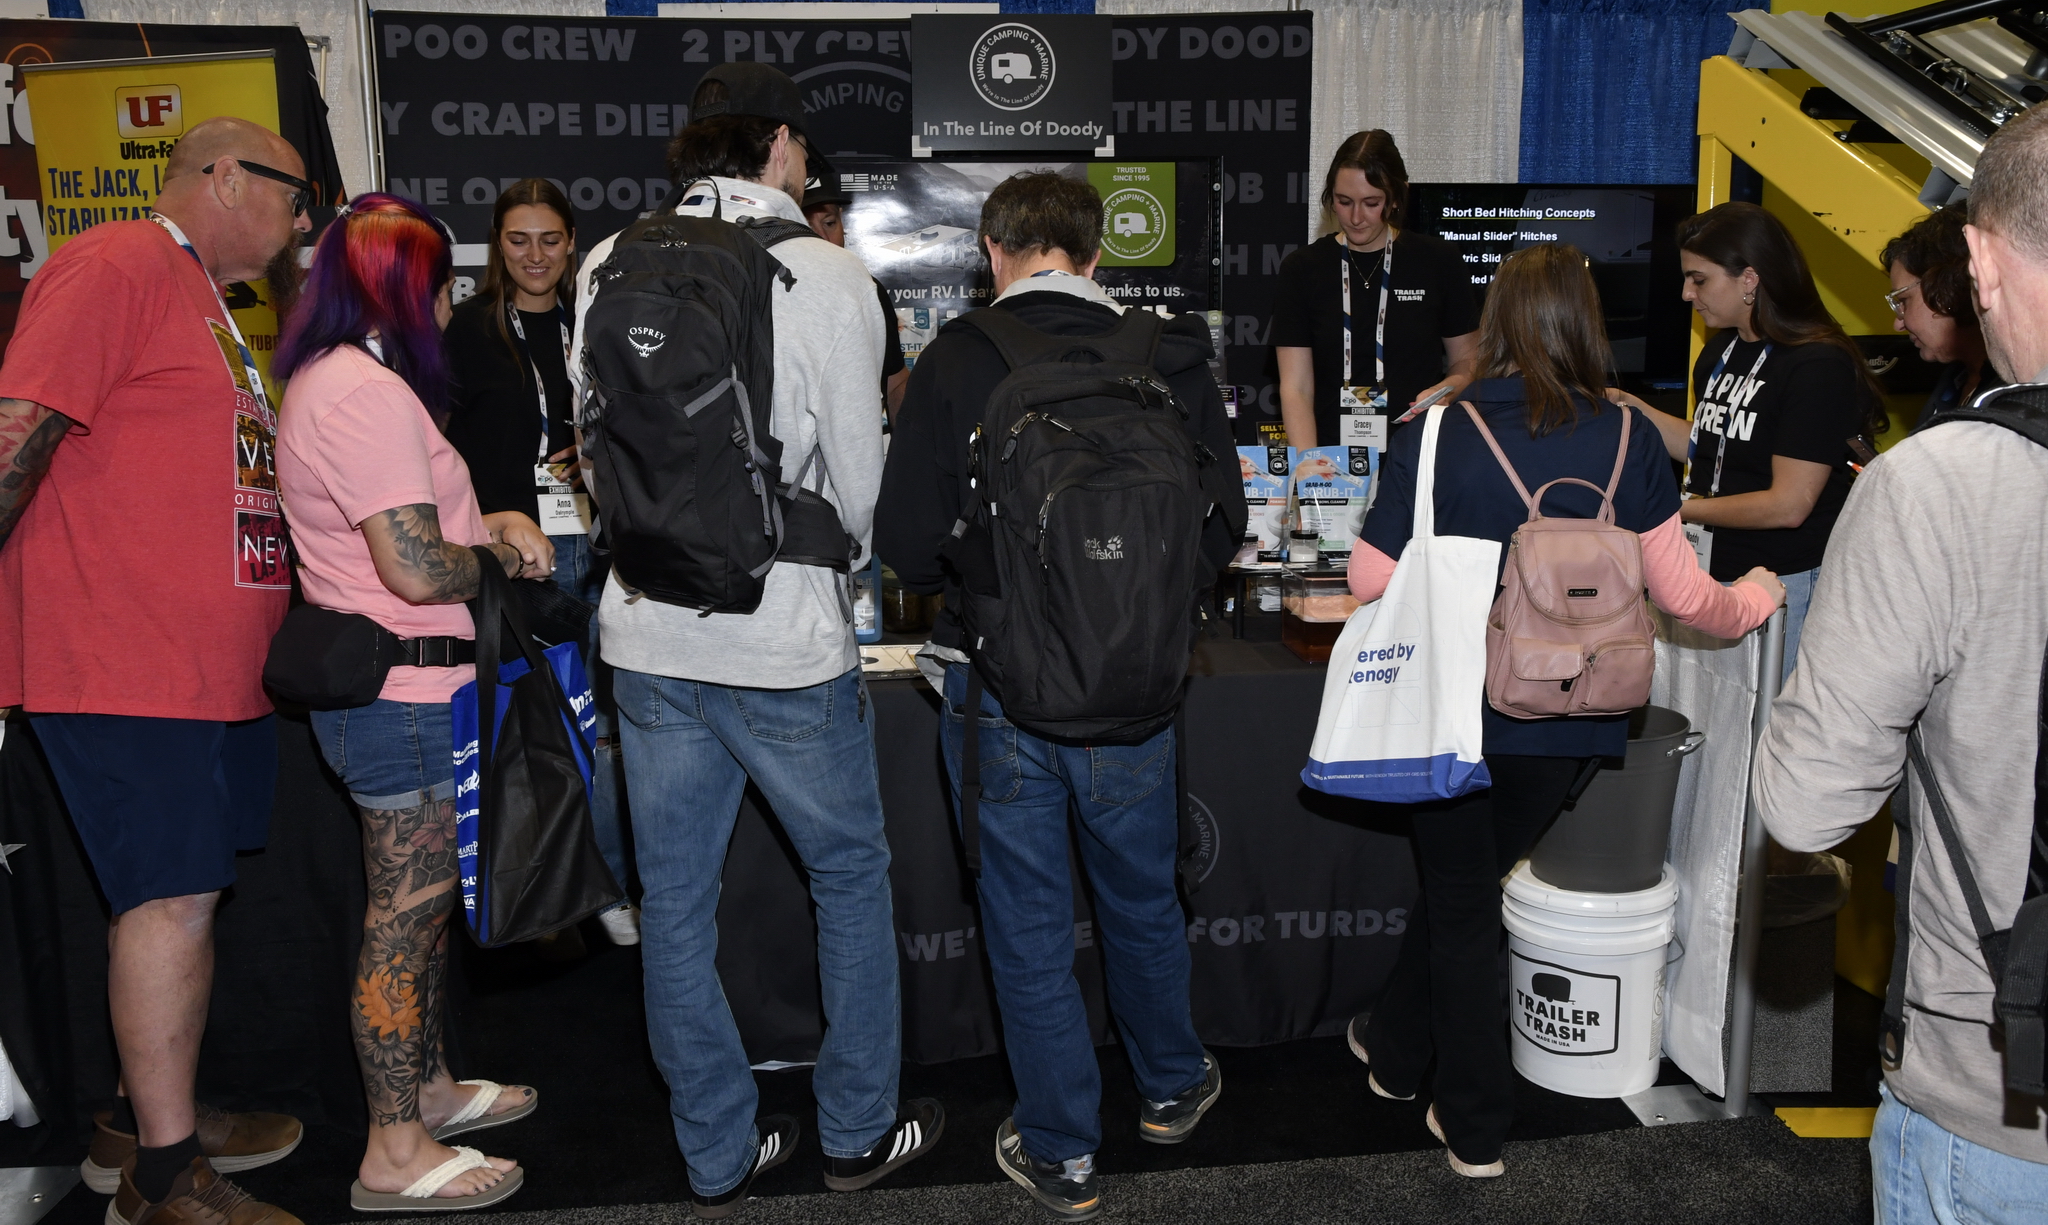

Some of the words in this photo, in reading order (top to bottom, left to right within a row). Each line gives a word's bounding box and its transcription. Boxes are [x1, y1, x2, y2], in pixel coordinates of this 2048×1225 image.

[385, 24, 488, 60] POO
[501, 25, 636, 61] CREW
[682, 29, 710, 62] 2
[724, 31, 804, 63] PLY
[976, 44, 990, 81] UNIQUE
[986, 29, 1030, 47] CAMPING
[1034, 42, 1050, 81] MARINE
[1000, 96, 1011, 104] The
[1029, 83, 1045, 99] Doody
[431, 102, 595, 136] CRAPE
[1112, 101, 1193, 133] THE
[1204, 99, 1297, 131] LINE
[923, 121, 940, 136] In
[943, 120, 975, 136] The
[979, 120, 1016, 136] Line
[1019, 120, 1043, 136] Of
[1046, 120, 1104, 140] Doody
[154, 164, 168, 195] L
[1116, 166, 1147, 174] TRUSTED
[1134, 174, 1151, 182] 1995
[1103, 205, 1114, 235] UNIQUE
[1110, 193, 1146, 207] CAMPING
[1148, 204, 1161, 235] MARINE
[1442, 207, 1472, 218] Short
[1474, 207, 1496, 218] Bed
[1498, 207, 1543, 220] Hitching
[1545, 207, 1596, 220] Concepts
[1439, 231, 1481, 241] "Manual
[1483, 231, 1518, 241] Slider"
[1519, 231, 1558, 241] Hitches
[894, 287, 928, 303] your
[931, 285, 956, 299] RV.
[1145, 284, 1162, 298] to
[1163, 284, 1185, 298] us.
[1393, 288, 1426, 296] TRAILER
[629, 326, 667, 341] OSPREY
[1351, 407, 1376, 415] EXHIBITOR
[1353, 420, 1373, 430] Gracey
[1269, 432, 1288, 440] FOR
[1303, 487, 1356, 498] SCRUB-IT
[556, 499, 572, 508] Anna
[1397, 642, 1416, 662] by
[1191, 811, 1211, 860] MARINE
[1274, 907, 1408, 941] TURDS
[1516, 988, 1601, 1027] TRAILER
[1523, 1011, 1587, 1043] TRASH
[1535, 1033, 1551, 1044] MADE
[1558, 1040, 1571, 1048] USA
